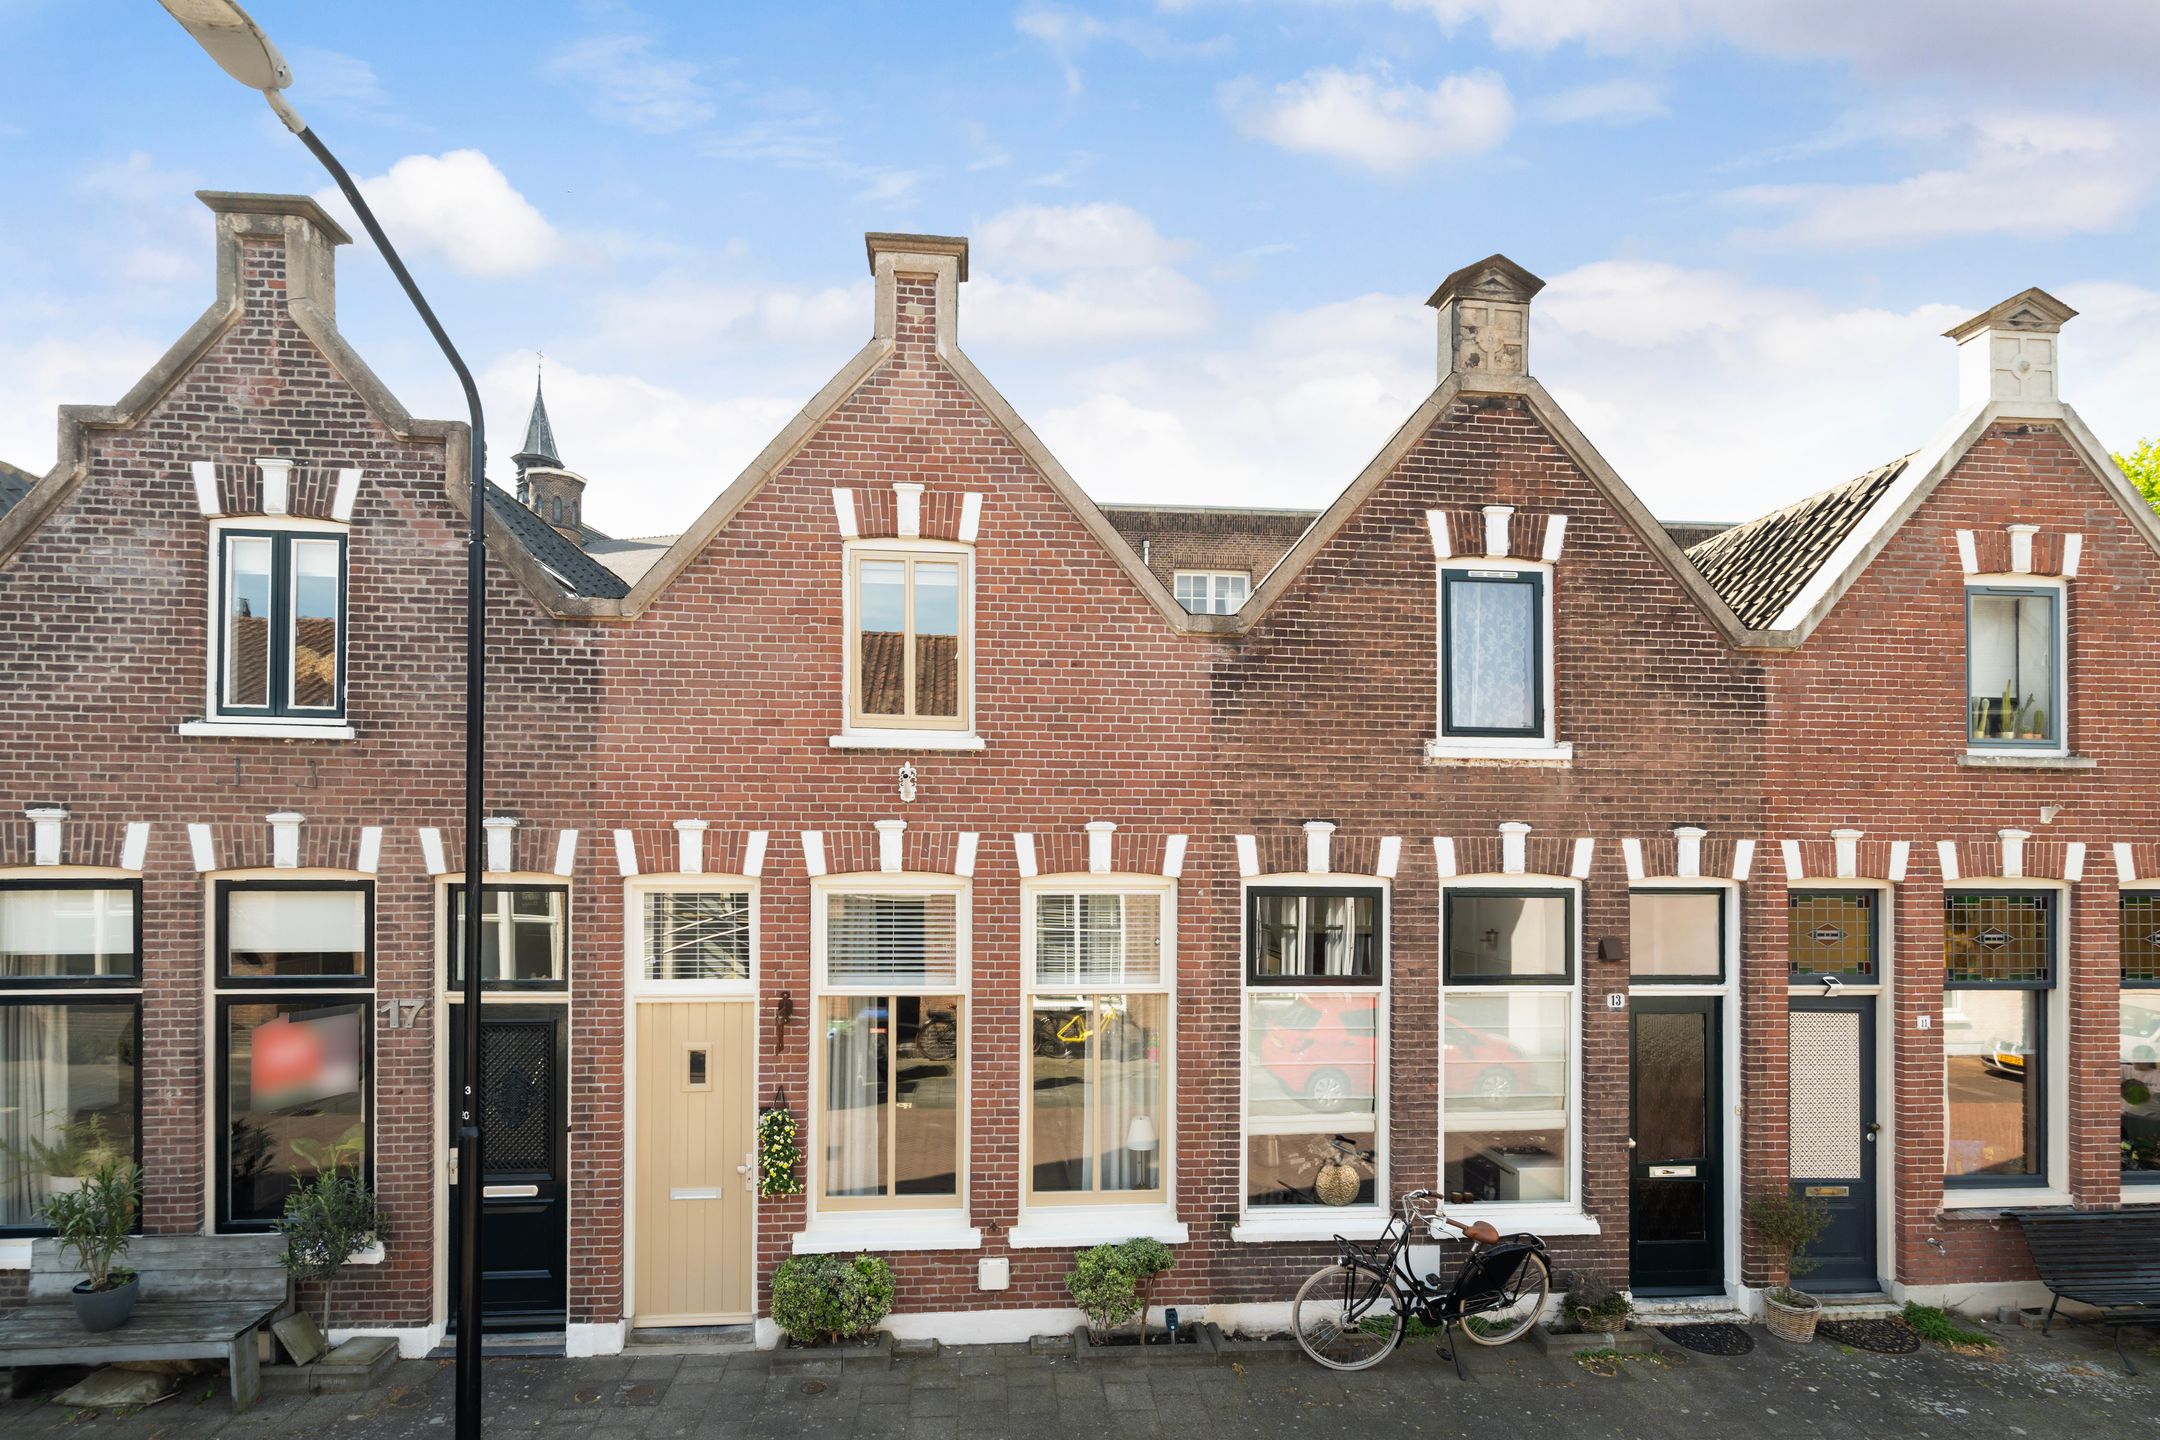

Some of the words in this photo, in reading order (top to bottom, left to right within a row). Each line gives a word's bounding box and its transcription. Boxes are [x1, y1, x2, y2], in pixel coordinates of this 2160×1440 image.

[1611, 994, 1621, 1006] 13
[380, 998, 426, 1029] 17
[464, 1085, 472, 1095] 3
